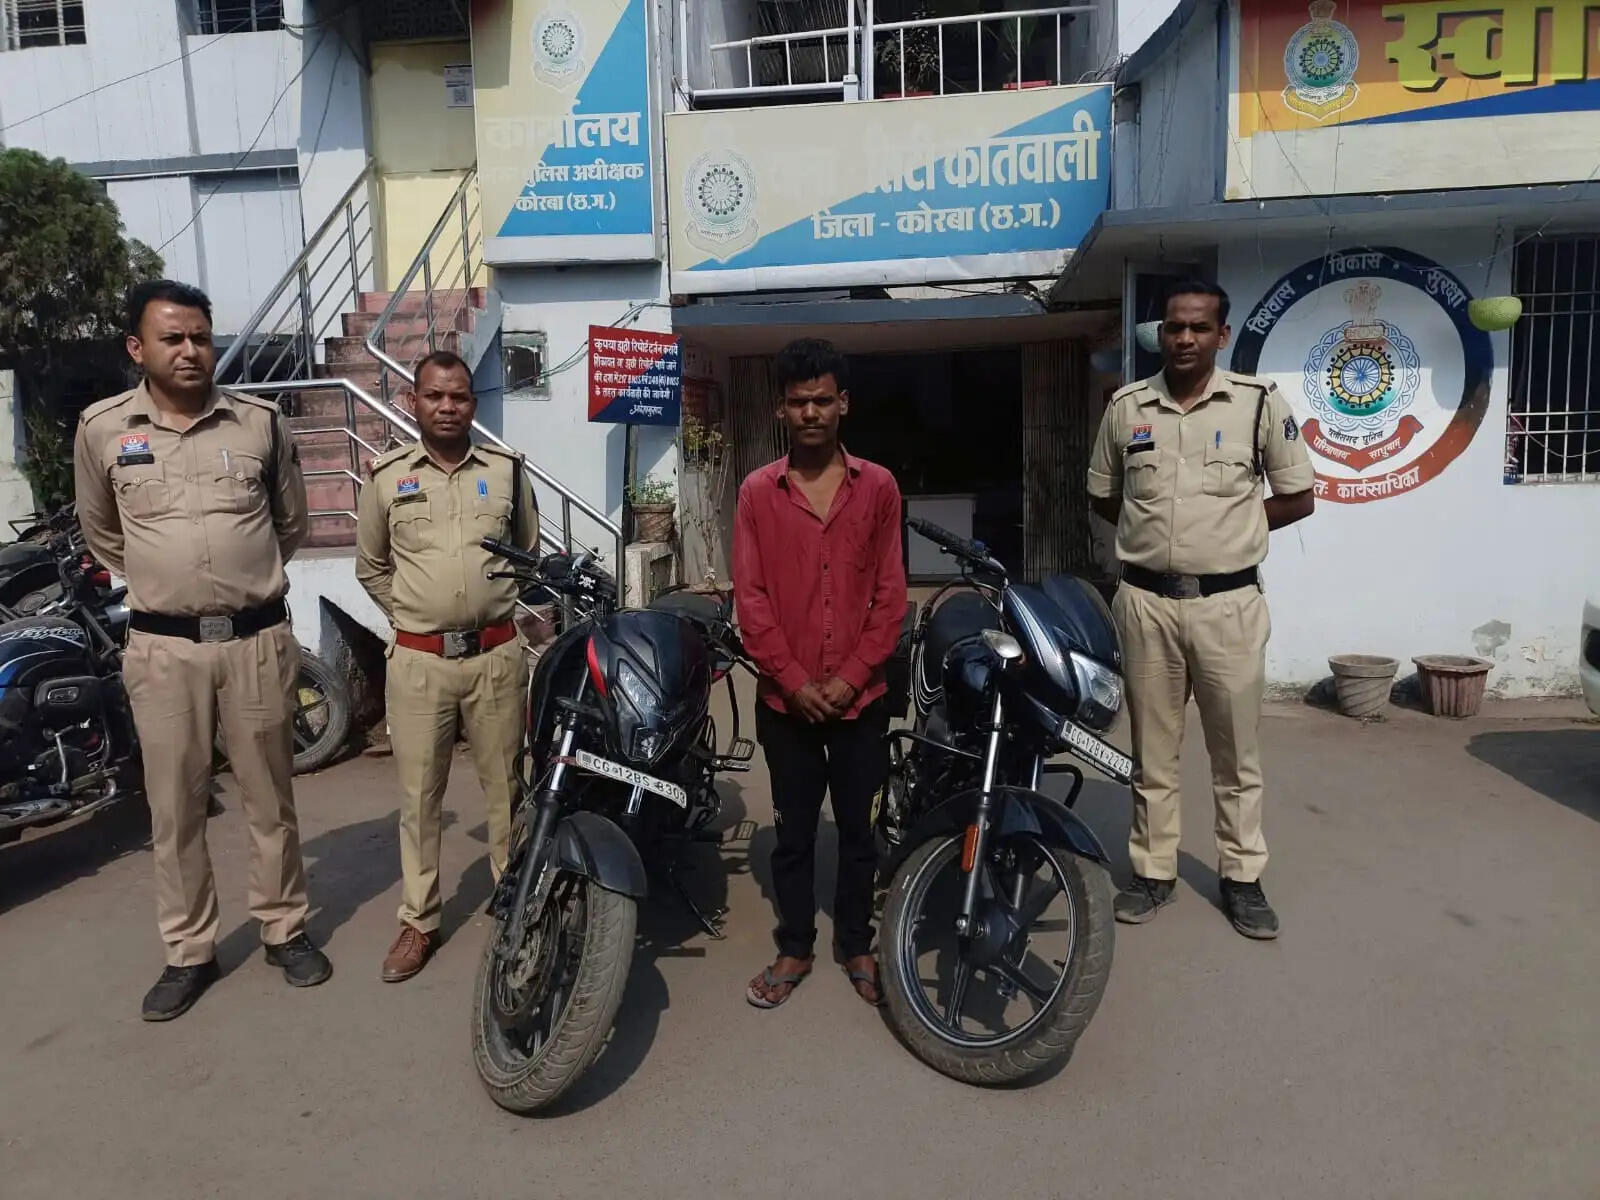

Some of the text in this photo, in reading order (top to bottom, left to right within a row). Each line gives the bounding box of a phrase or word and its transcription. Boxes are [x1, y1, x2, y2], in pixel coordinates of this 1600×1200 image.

[1382, 0, 1600, 92] स्वा
[572, 158, 644, 182] अधीक्षक
[515, 191, 564, 212] कोरबा
[811, 207, 875, 240] जिला
[896, 201, 975, 235] कोरबा
[1328, 252, 1383, 275] विकास
